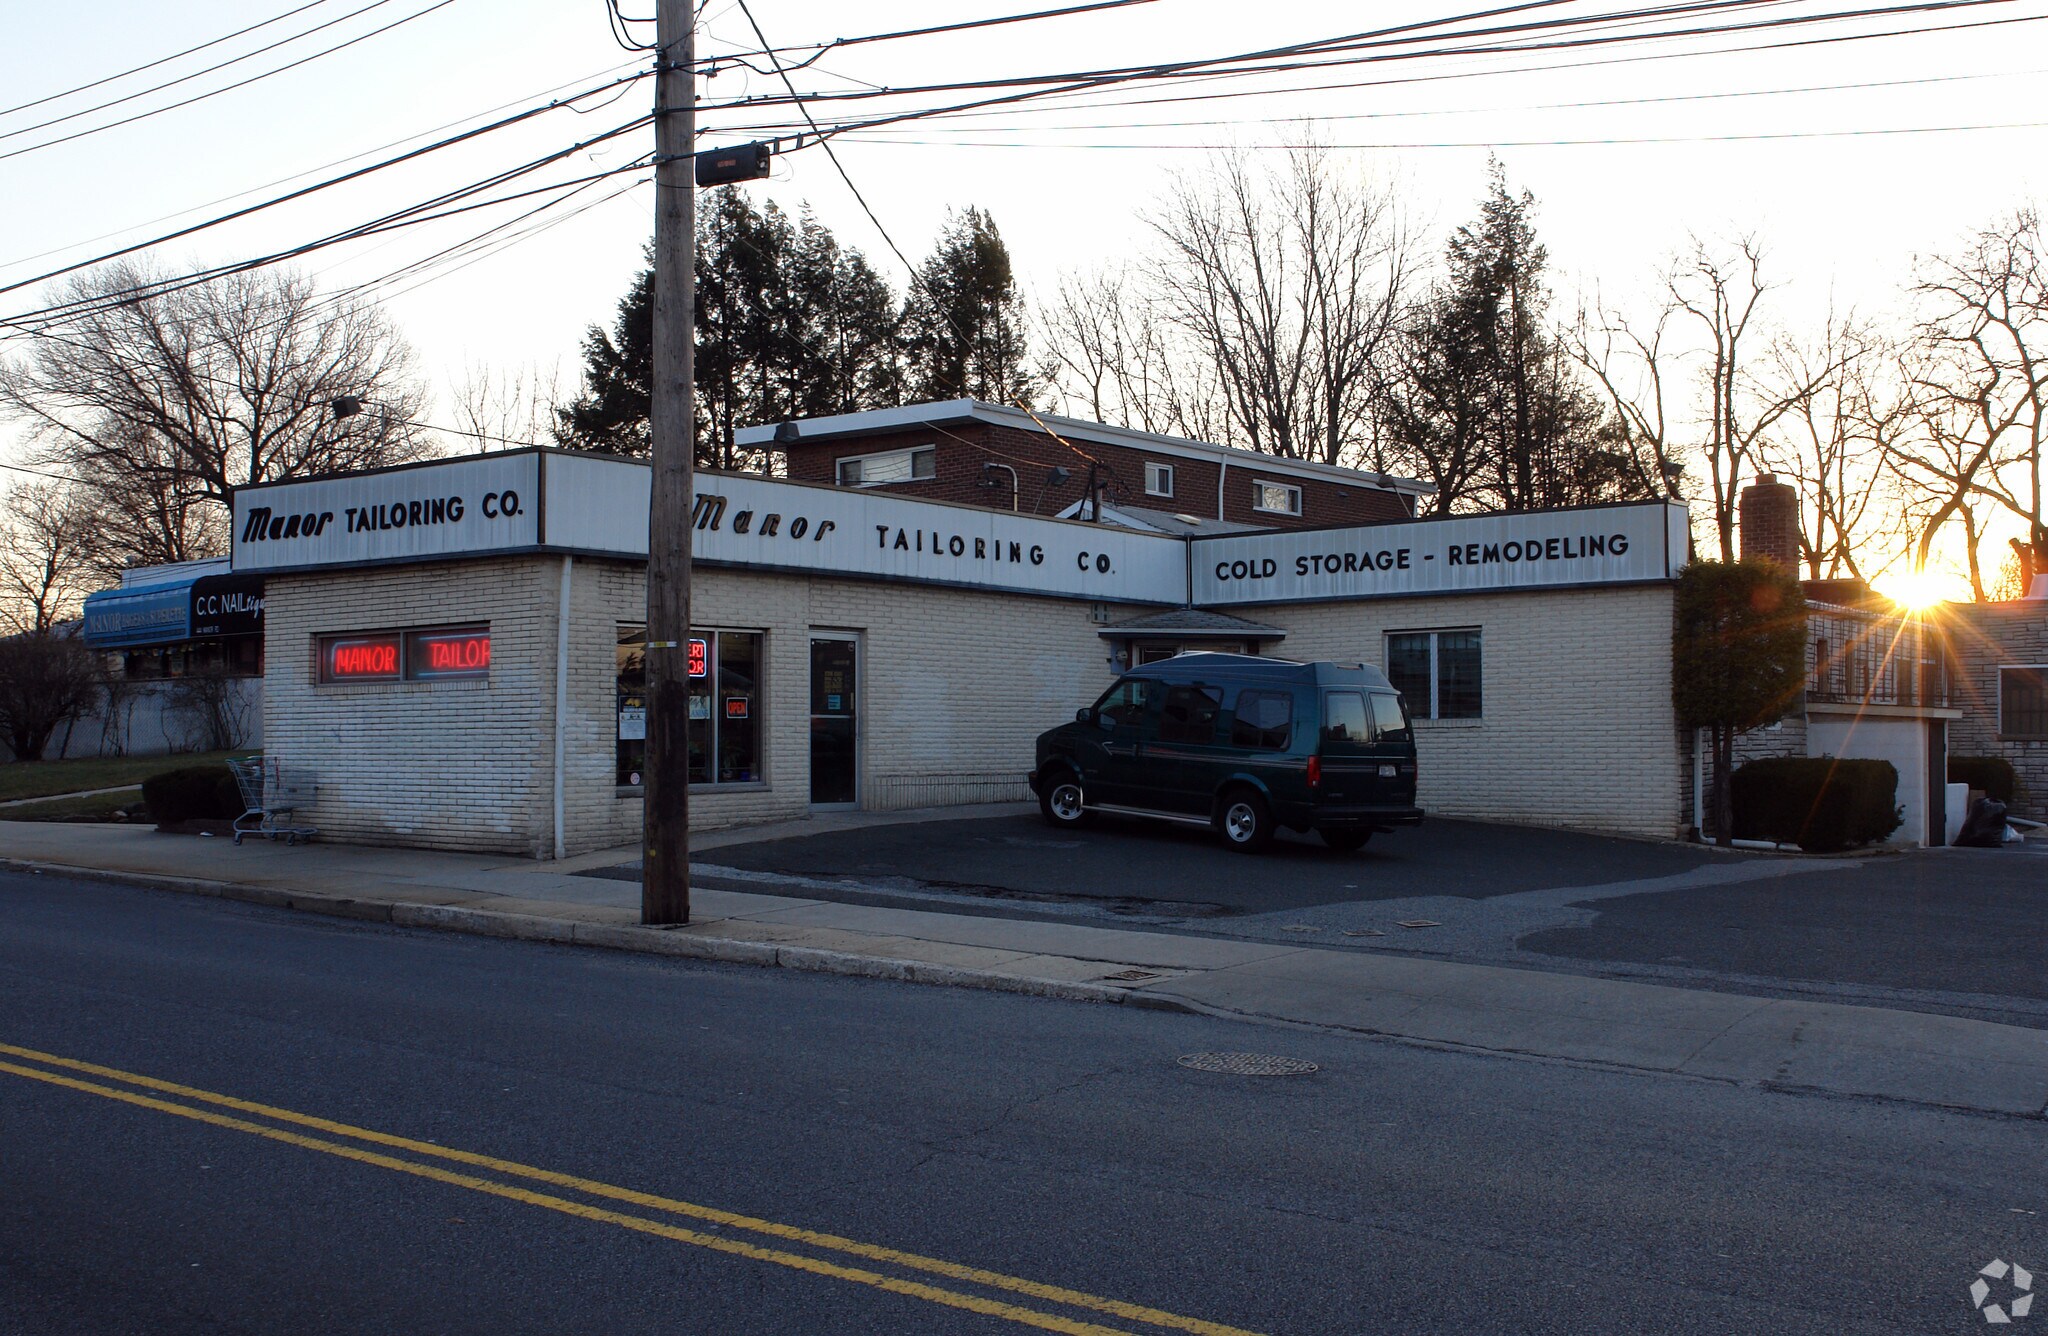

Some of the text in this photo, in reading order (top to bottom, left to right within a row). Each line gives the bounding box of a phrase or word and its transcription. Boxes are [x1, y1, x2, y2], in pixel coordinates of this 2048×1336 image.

[241, 490, 523, 543] Manor TAILORING CO.
[692, 492, 1116, 575] Manor TAILORING CO.
[1215, 558, 1277, 581] COLD
[1296, 548, 1411, 576] STORAGE
[1449, 533, 1629, 566] REMODELING
[335, 645, 396, 674] MANOR
[728, 701, 746, 715] OPEN
